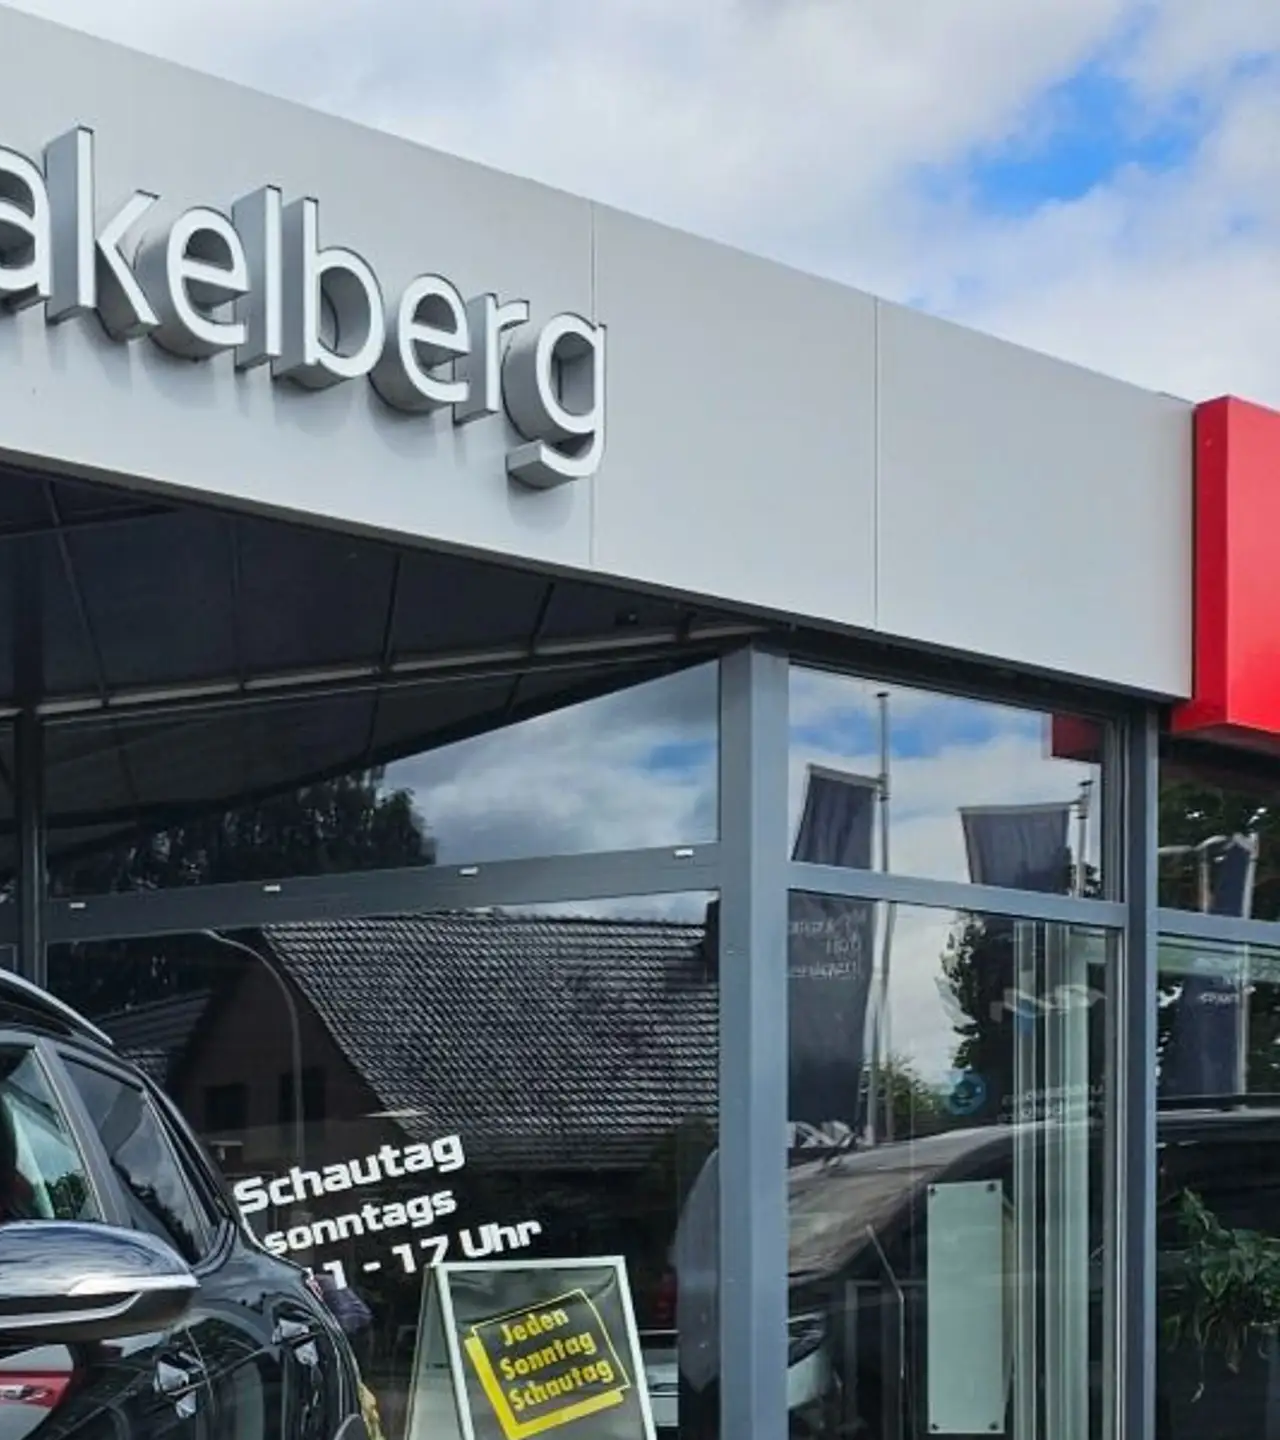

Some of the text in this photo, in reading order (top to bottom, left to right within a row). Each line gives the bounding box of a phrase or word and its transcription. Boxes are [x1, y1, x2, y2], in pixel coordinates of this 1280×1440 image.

[233, 1134, 466, 1214] Schautag
[262, 1189, 458, 1255] sonntags
[391, 1235, 449, 1274] 17
[459, 1220, 542, 1259] Uhr
[500, 1307, 569, 1346] Jeden
[499, 1332, 597, 1381] Sonntag
[508, 1359, 615, 1412] Schautag
